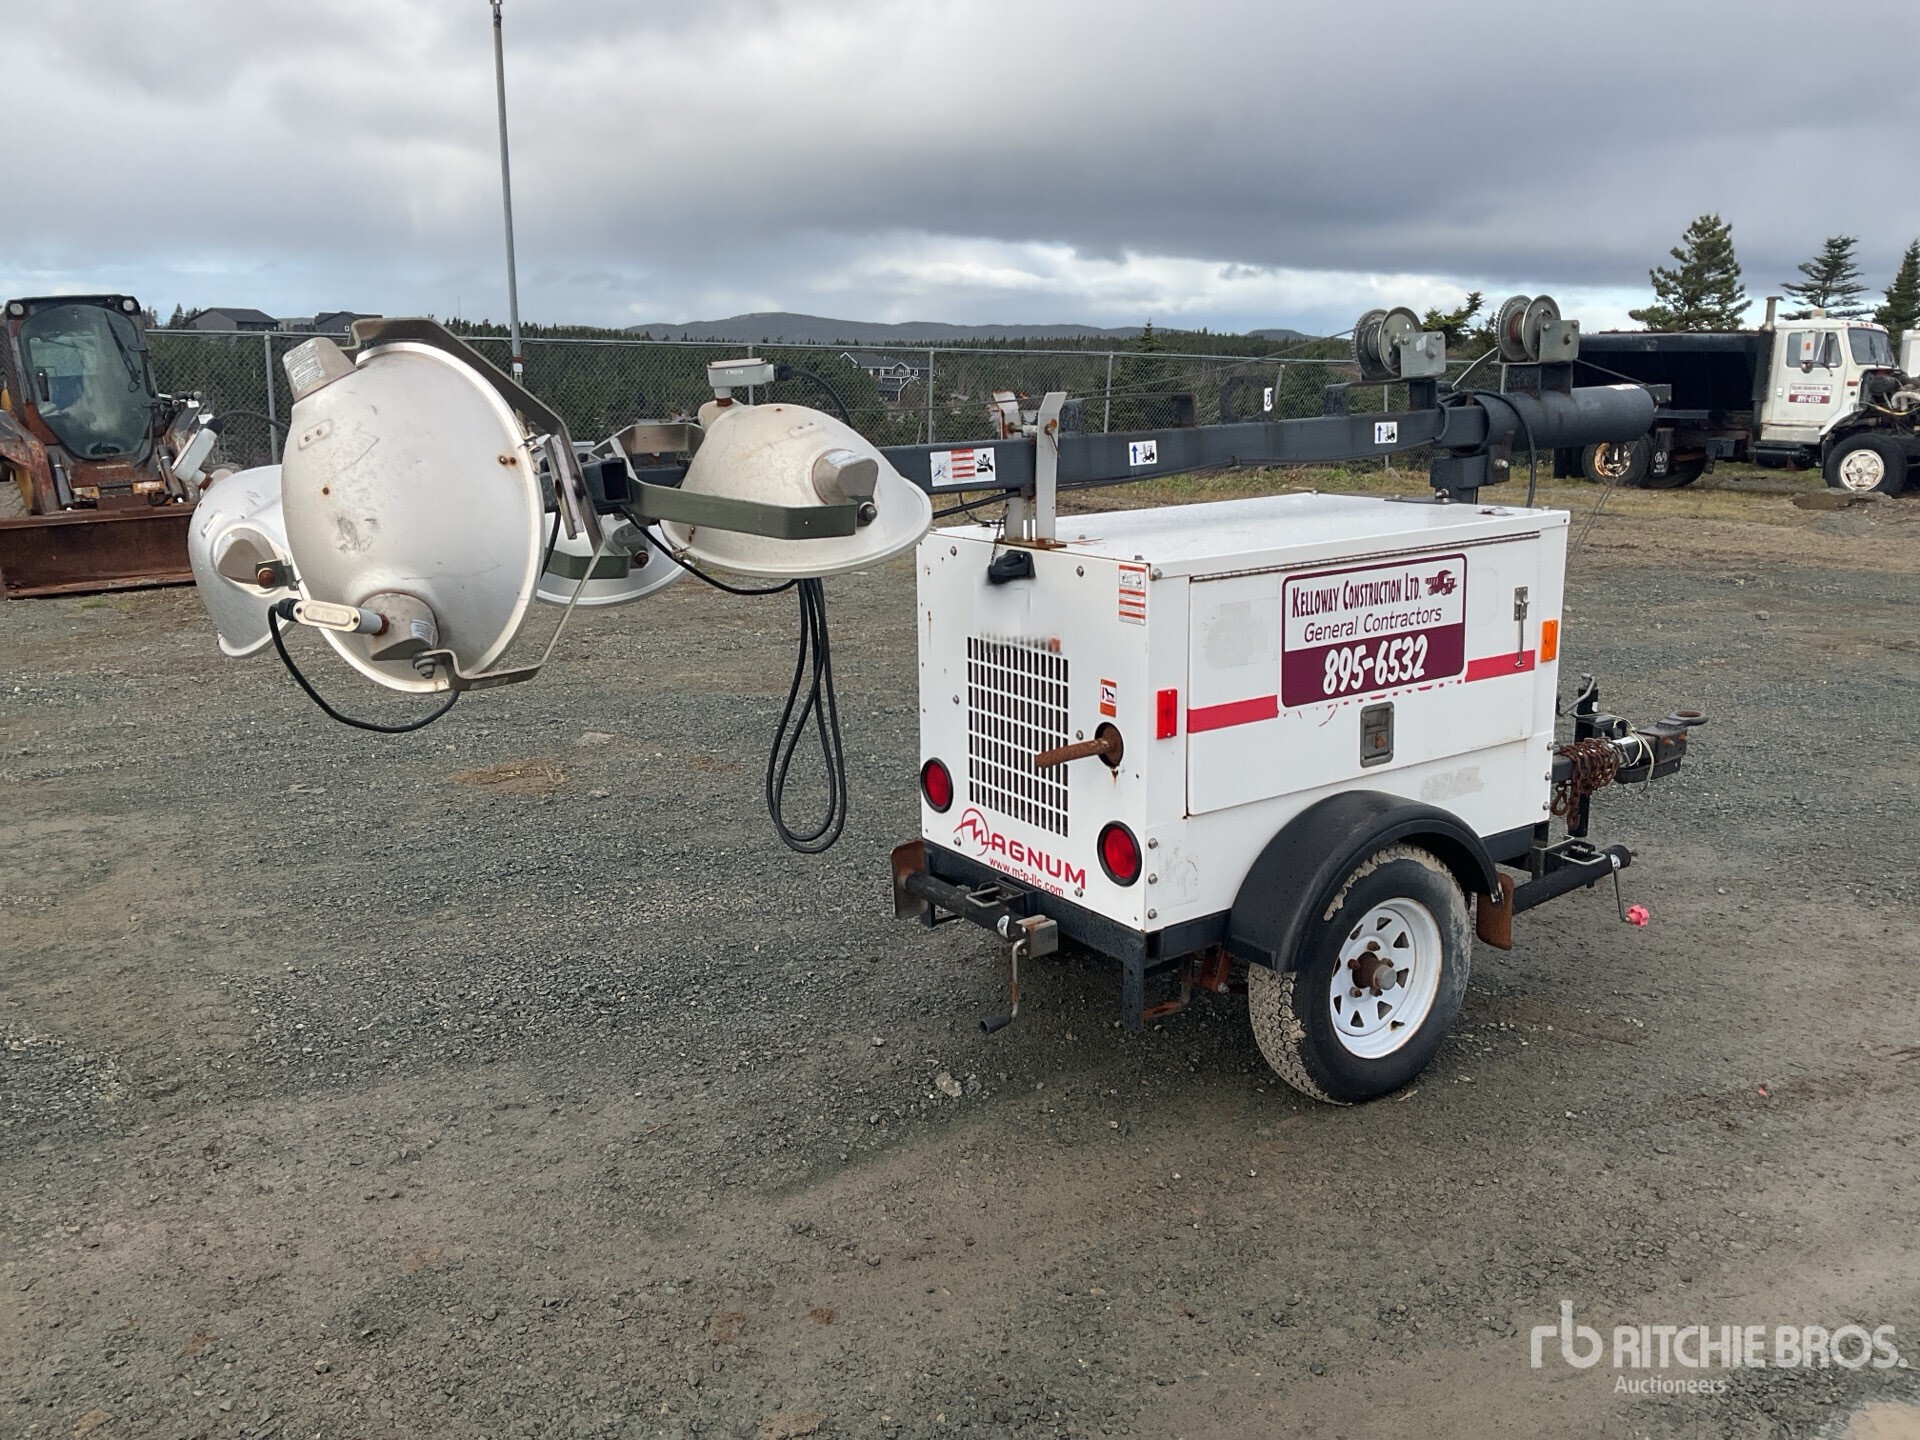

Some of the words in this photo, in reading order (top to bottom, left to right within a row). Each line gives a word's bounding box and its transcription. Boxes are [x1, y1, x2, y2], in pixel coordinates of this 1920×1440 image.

[1292, 587, 1339, 618] KELLOWAY
[1343, 579, 1401, 611] CONSTRUCTION
[1304, 615, 1359, 643] General
[1363, 606, 1442, 633] Contractors
[1322, 634, 1428, 695] 895-6532
